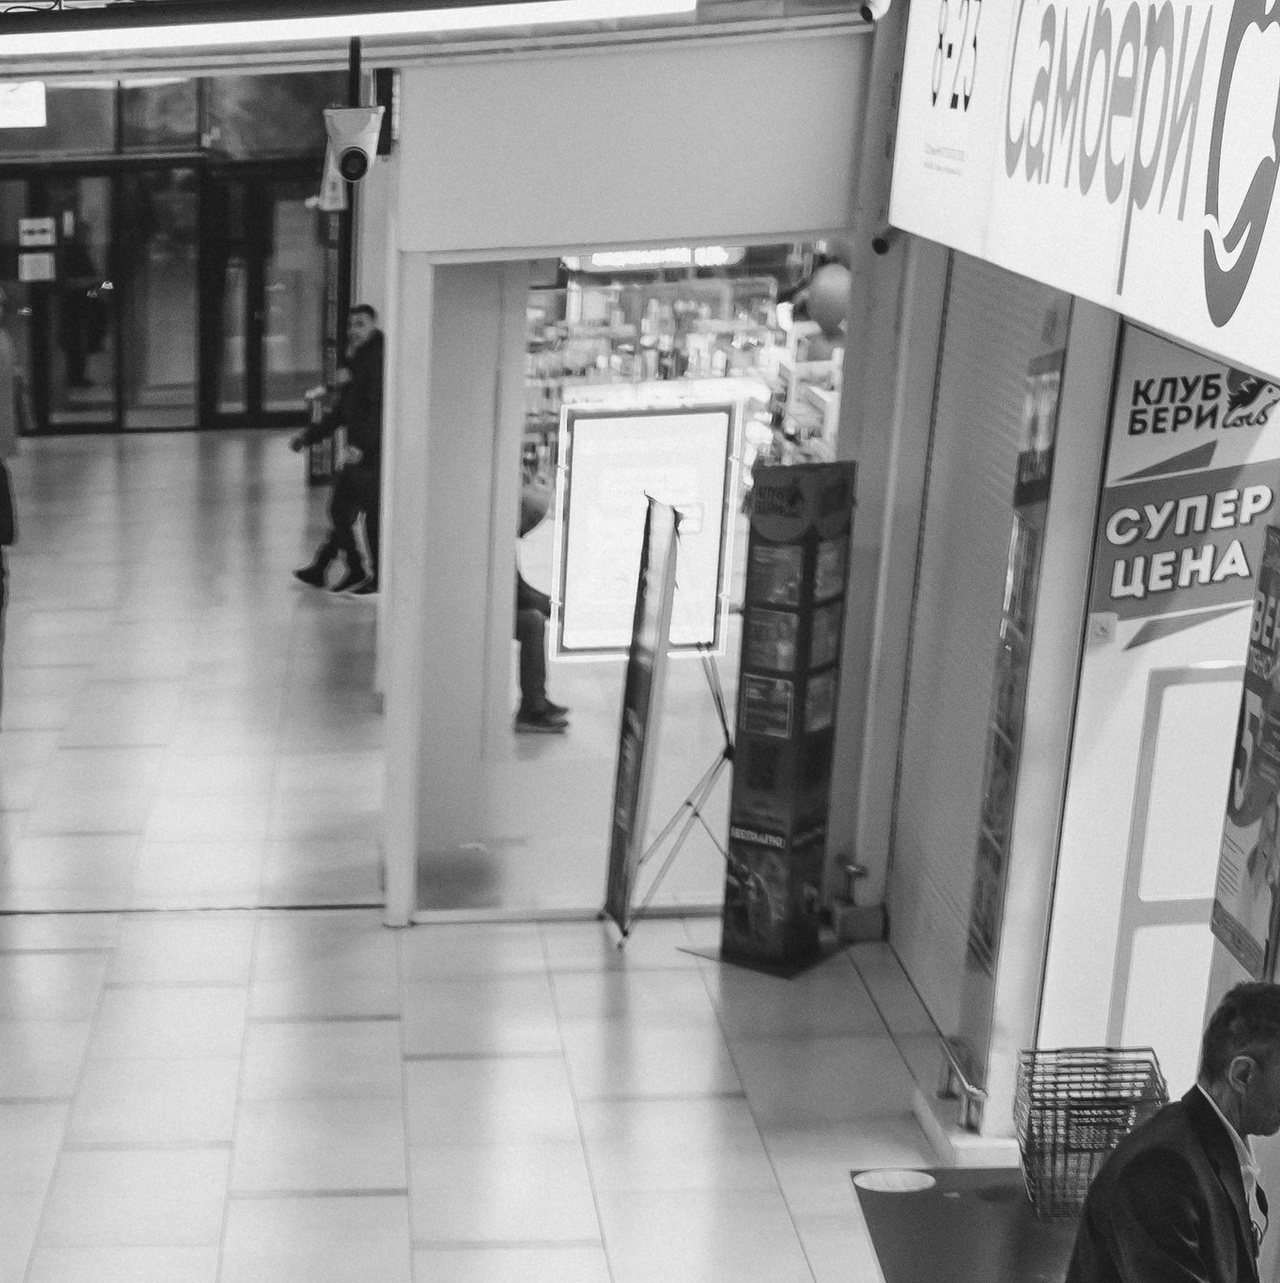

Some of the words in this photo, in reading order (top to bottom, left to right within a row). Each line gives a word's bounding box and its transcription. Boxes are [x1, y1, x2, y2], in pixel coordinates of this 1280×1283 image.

[1005, 0, 1212, 294] Самбери
[1128, 403, 1219, 435] БЕРИ
[1131, 373, 1222, 406] КЛУБ
[1106, 485, 1273, 546] СУПЕР
[1111, 539, 1251, 598] ЦЕНА
